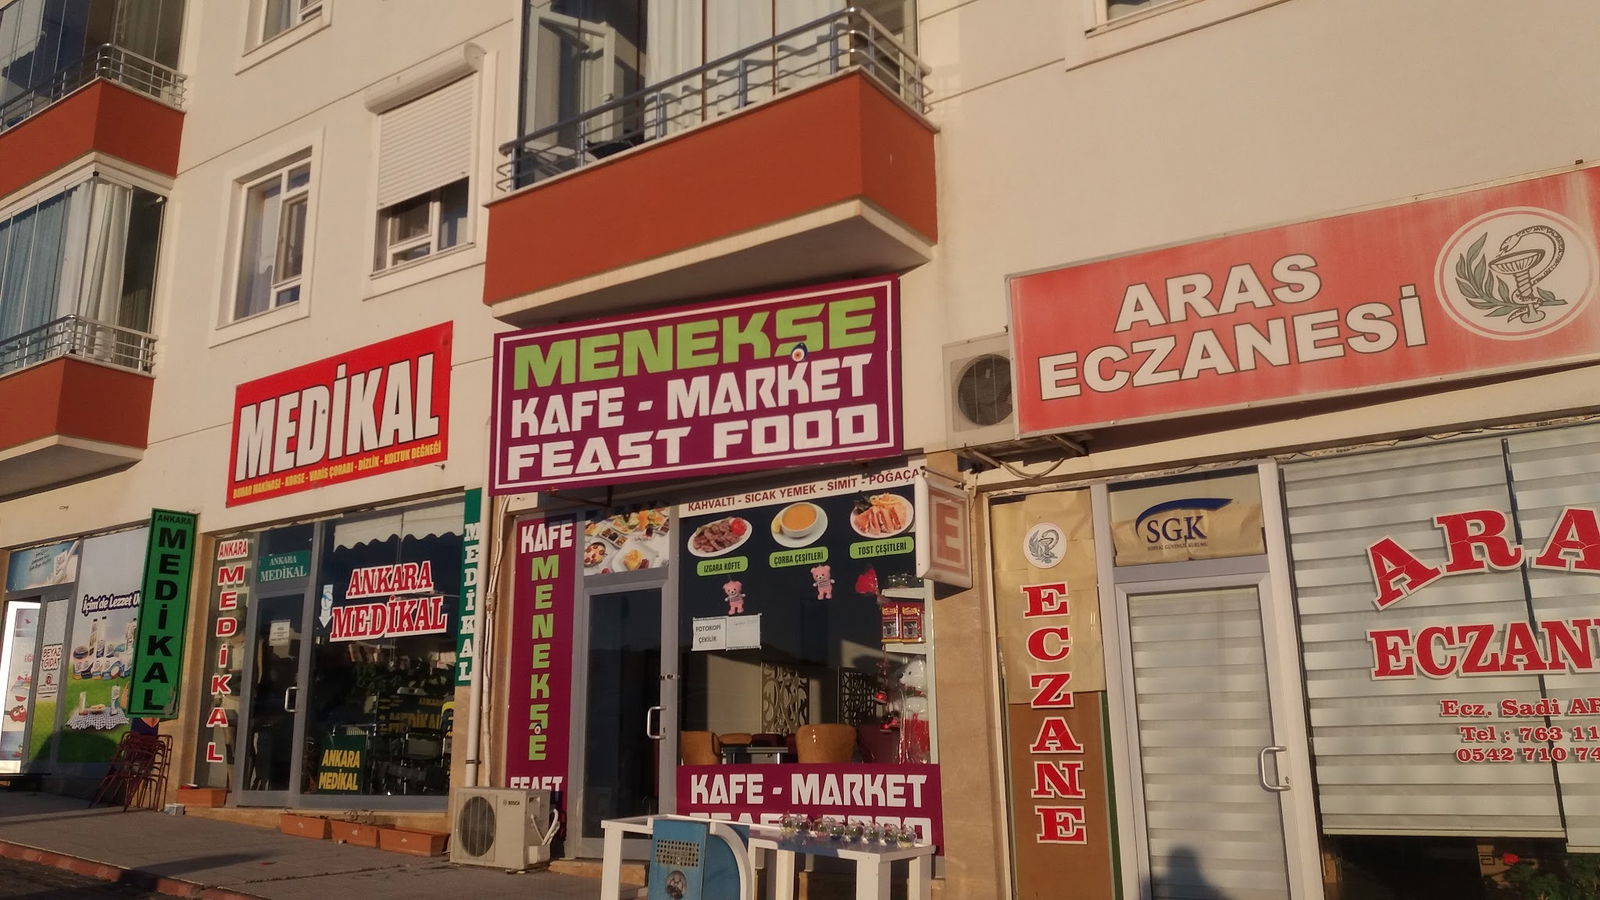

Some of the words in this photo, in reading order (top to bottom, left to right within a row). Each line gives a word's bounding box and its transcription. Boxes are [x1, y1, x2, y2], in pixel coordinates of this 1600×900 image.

[1114, 253, 1322, 333] ARAS
[1037, 284, 1428, 401] ECZANESİ
[511, 387, 625, 439] KAFE
[666, 353, 872, 421] MARKET
[234, 352, 440, 483] MEDİKAL
[507, 426, 691, 481] FEAST
[713, 403, 879, 460] FOOD
[688, 495, 735, 512] KAHVALTI
[745, 490, 776, 504] SICAK
[779, 484, 816, 499] YEMEK
[157, 514, 192, 525] ANKARA
[936, 502, 961, 564] E
[1147, 515, 1207, 543] SGK
[218, 540, 248, 560] ANKARA
[521, 522, 573, 554] KAFE
[858, 546, 874, 556] TOST
[260, 565, 307, 582] MEDİKAL
[269, 556, 297, 566] ANKARA
[703, 563, 723, 573] IZGARA
[724, 561, 741, 571] KÖFTE
[774, 553, 793, 565] ÇORBA
[346, 560, 433, 599] ANKARA
[143, 527, 187, 710] MEDİKAL
[330, 594, 448, 642] MEDİKAL
[206, 565, 245, 763] MEDİKAL
[1367, 618, 1600, 681] ECZAN
[1020, 581, 1087, 844] ECZANE
[1440, 700, 1492, 716] Ecz.
[1501, 698, 1562, 716] Sadi
[1460, 726, 1497, 741] Tel
[1519, 727, 1563, 741] 763
[321, 749, 360, 768] ANKARA
[1457, 748, 1514, 762] 0542
[1522, 747, 1567, 762] 710
[318, 769, 358, 790] MEDİKAL
[690, 773, 764, 805] KAFE
[791, 773, 927, 808] MARKET
